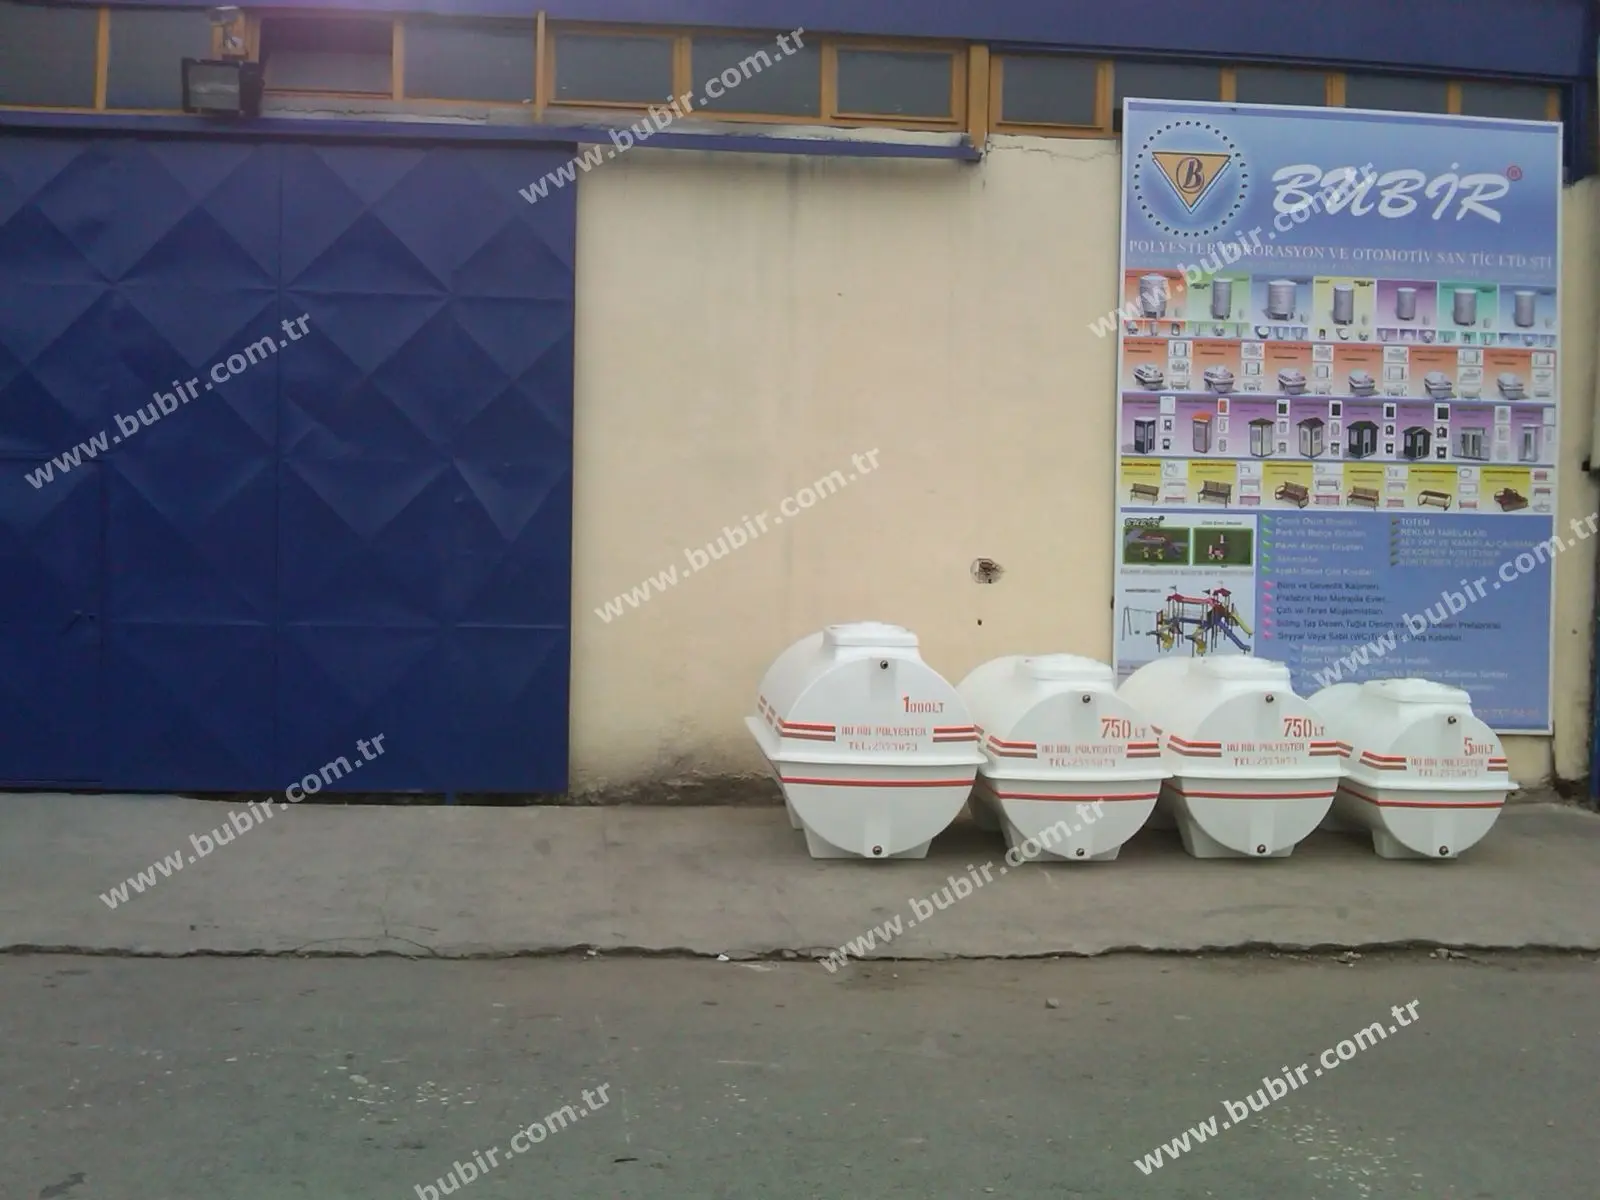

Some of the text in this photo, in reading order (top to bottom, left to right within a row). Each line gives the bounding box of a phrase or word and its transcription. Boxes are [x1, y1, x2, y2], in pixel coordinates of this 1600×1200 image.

[1128, 239, 1216, 255] POLYESTER
[1329, 247, 1349, 261] VE
[1437, 251, 1465, 265] SAN
[1101, 718, 1131, 739] 750
